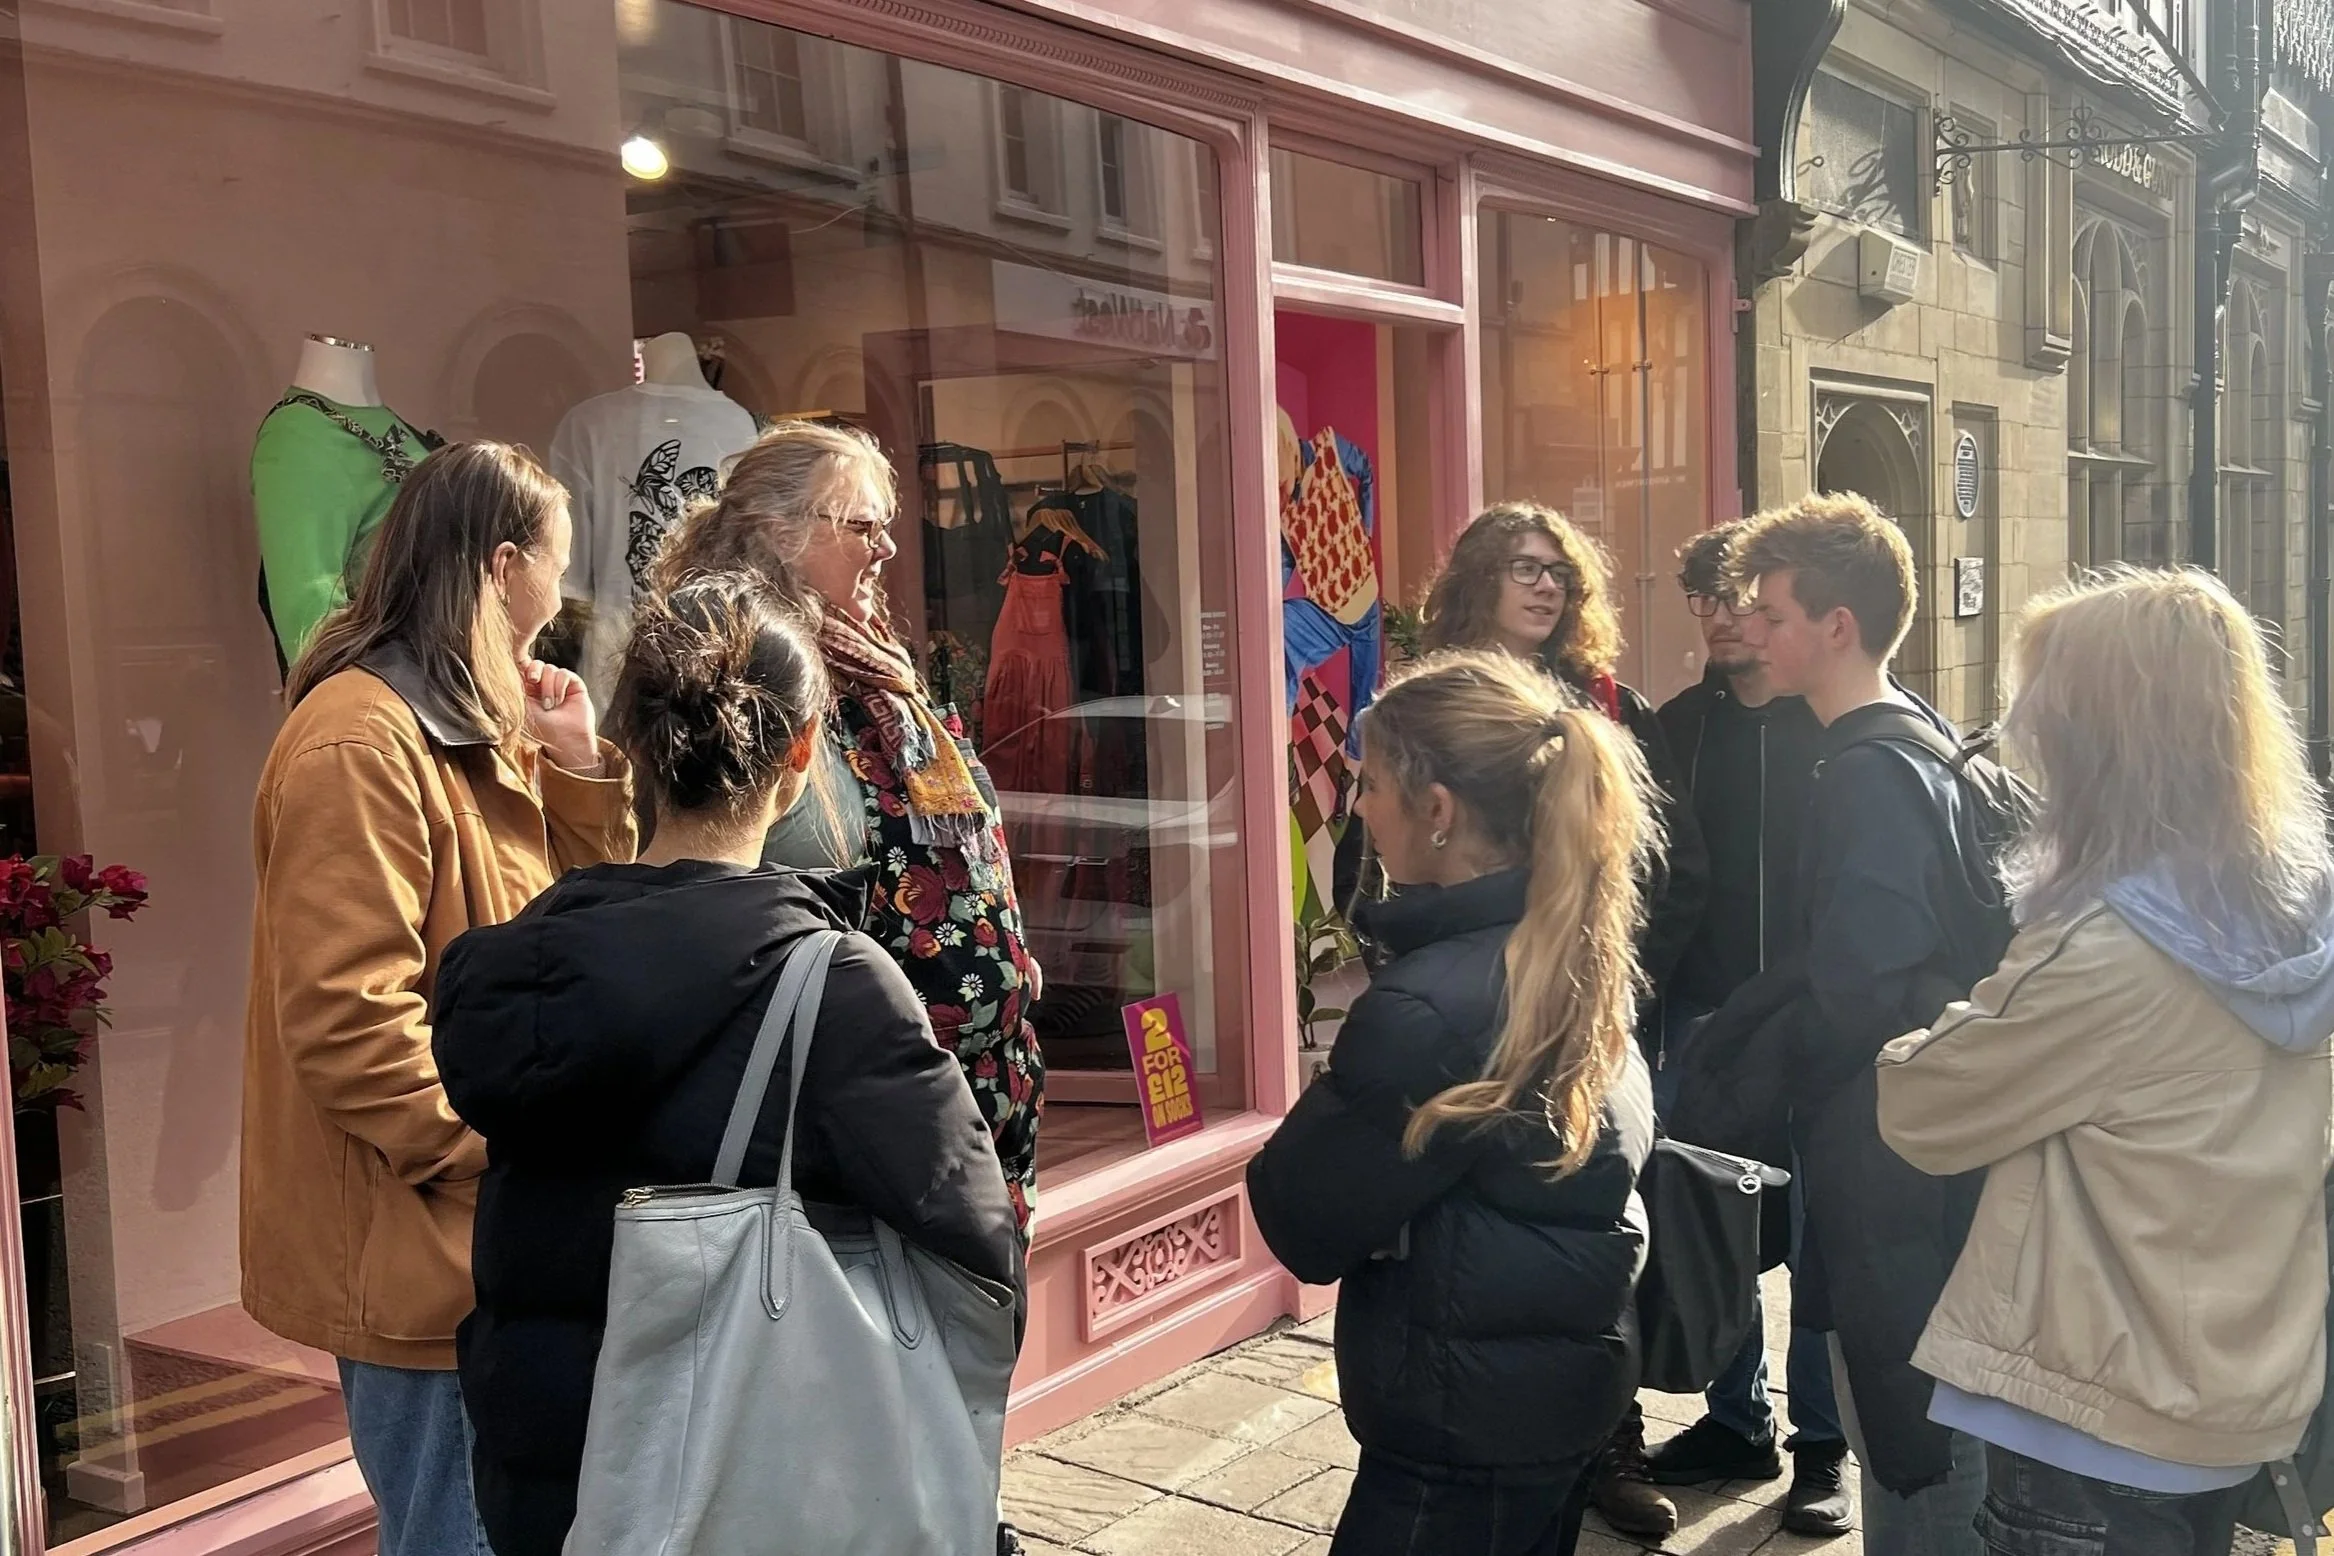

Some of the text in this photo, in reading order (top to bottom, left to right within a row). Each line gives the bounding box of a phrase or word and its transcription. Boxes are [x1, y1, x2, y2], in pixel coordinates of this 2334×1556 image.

[1141, 1007, 1172, 1053] 2
[1141, 1046, 1182, 1075] FOR
[1147, 1064, 1189, 1105] £12
